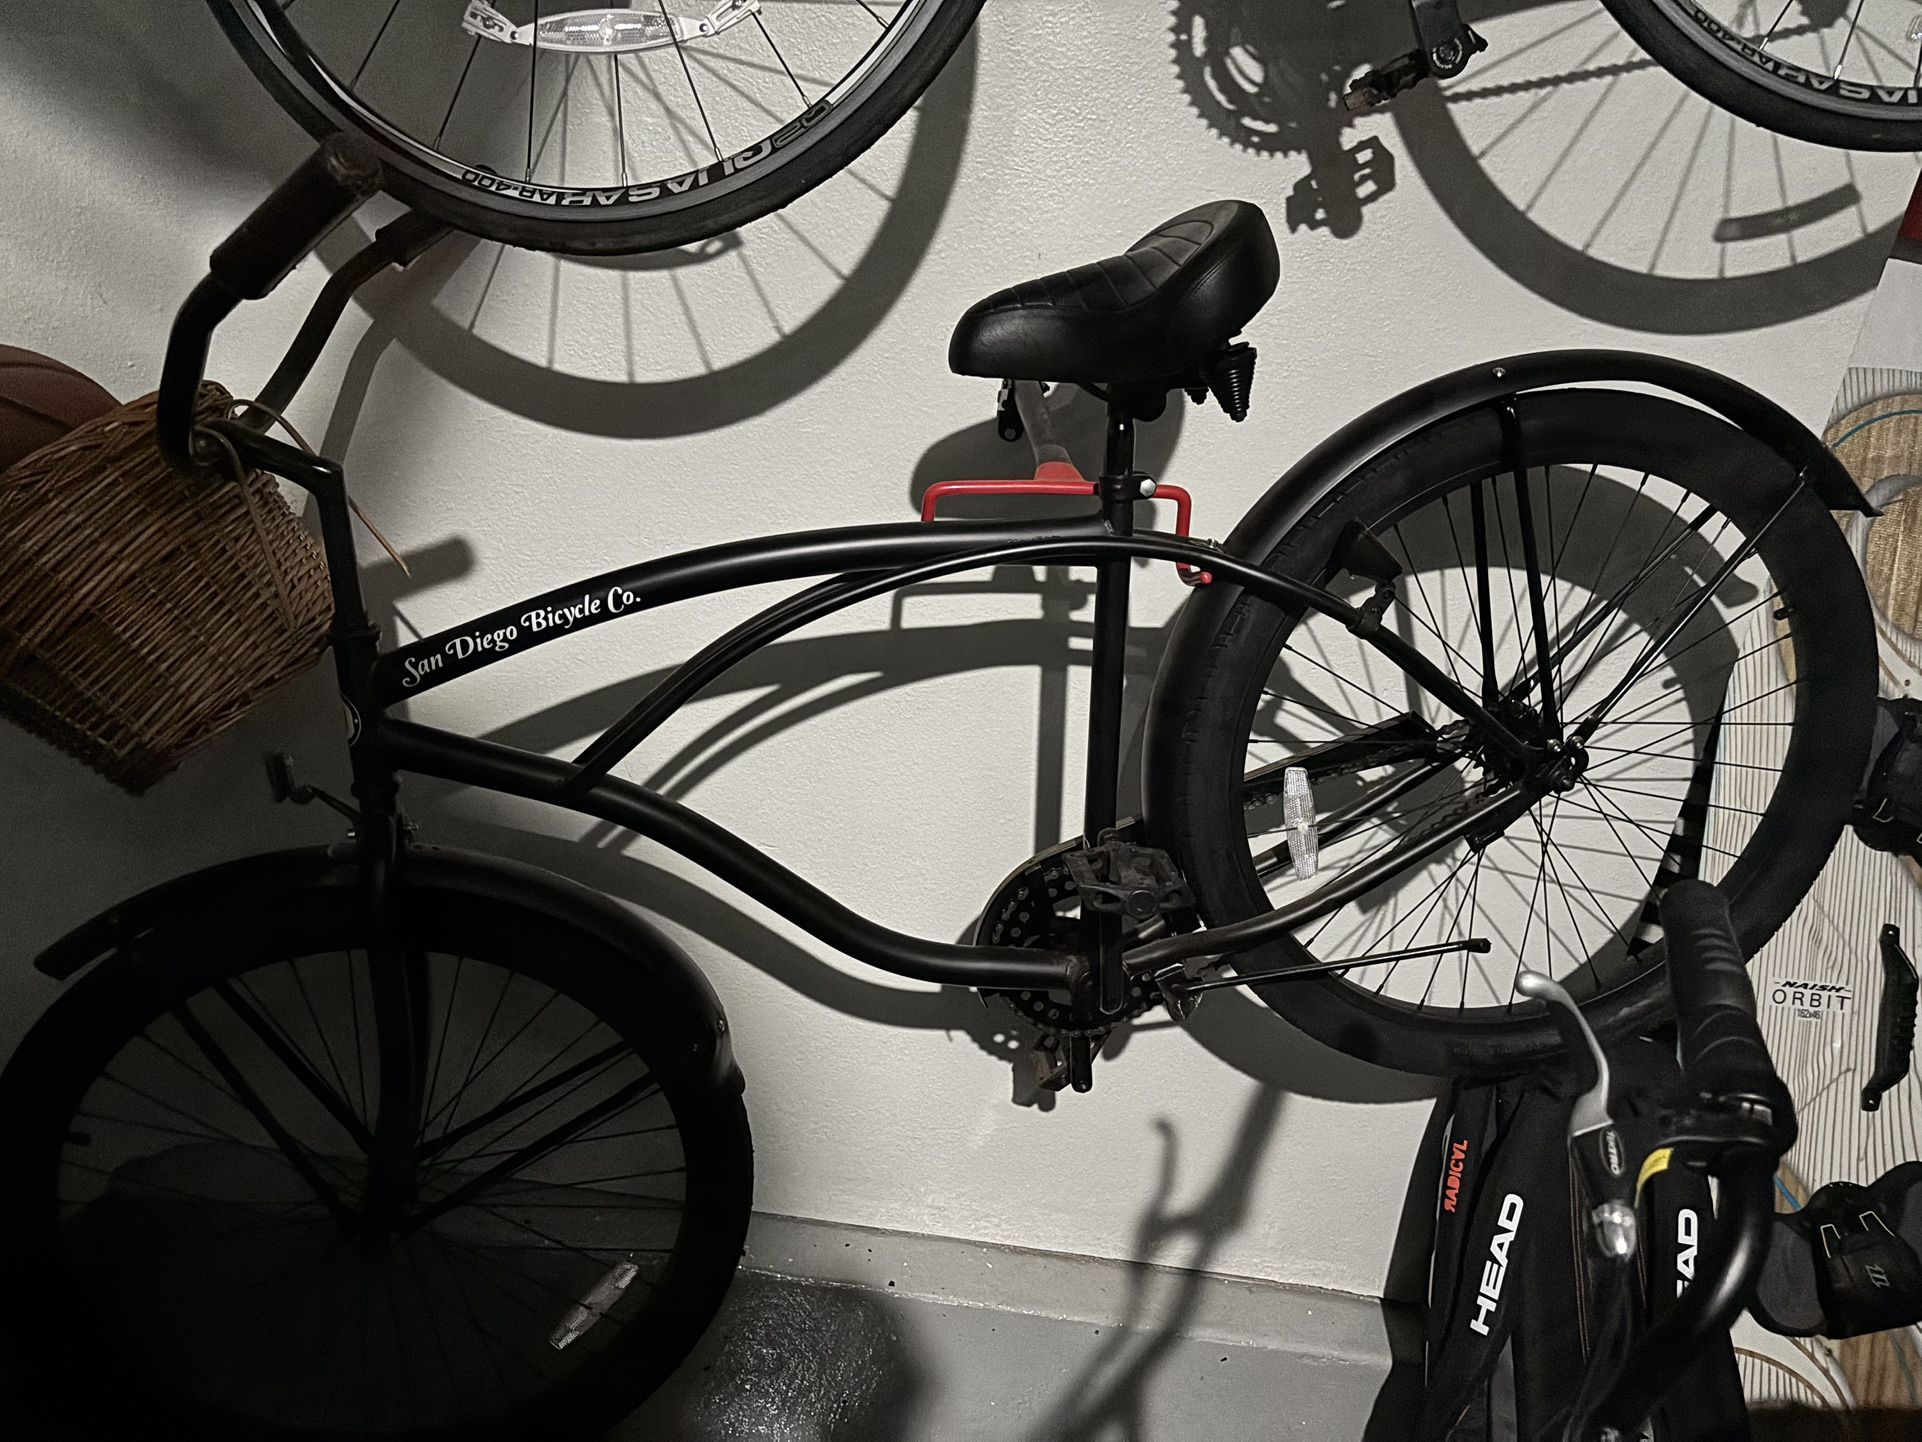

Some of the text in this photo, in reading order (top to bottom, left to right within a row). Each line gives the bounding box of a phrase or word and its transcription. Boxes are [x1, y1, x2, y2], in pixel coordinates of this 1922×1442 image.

[461, 169, 558, 204] AR-400
[402, 586, 642, 688] San Diego Bicycle Co.
[1772, 989, 1851, 1010] ORBIT
[1782, 980, 1845, 993] NAISH
[1469, 1193, 1524, 1336] HEAD
